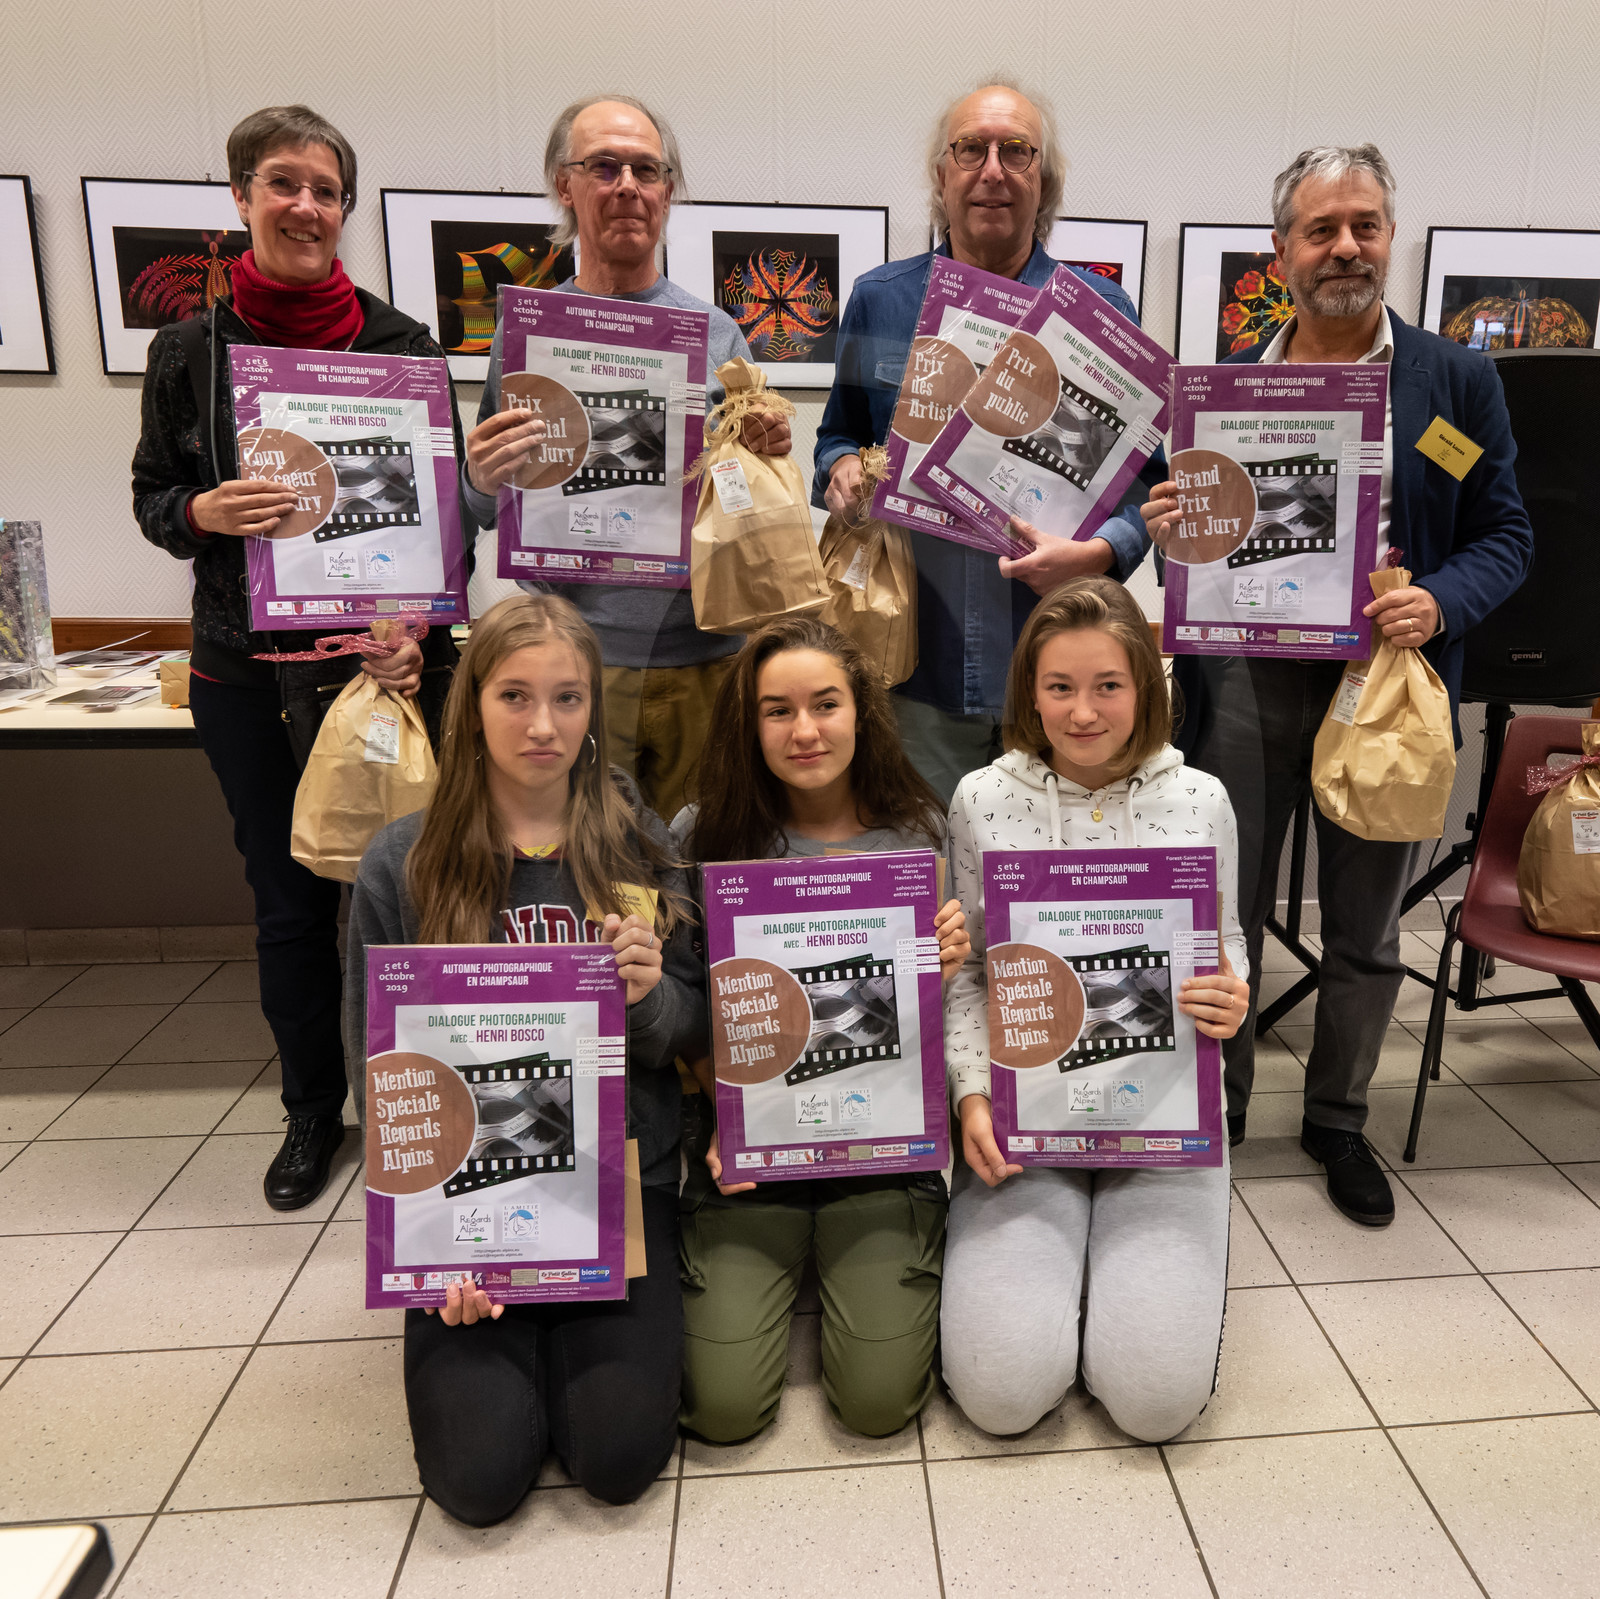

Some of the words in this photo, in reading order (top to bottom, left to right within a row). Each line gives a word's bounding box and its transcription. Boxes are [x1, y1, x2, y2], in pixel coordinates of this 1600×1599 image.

[939, 279, 964, 291] octobre
[942, 288, 958, 298] 2019
[984, 286, 1010, 302] AUTOMNE
[517, 298, 523, 306] 5
[998, 302, 1006, 310] EN
[513, 305, 542, 315] octobre
[566, 306, 596, 318] AUTOMNE
[598, 309, 652, 325] PHOTOGRAPHIQUE
[518, 315, 536, 325] 2019
[585, 319, 594, 328] EN
[595, 320, 634, 333] CHAMPSAUR
[964, 320, 997, 338] DIALOGUE
[1092, 308, 1117, 331] AUTOMNE
[1114, 326, 1156, 363] PHOTOGRAPHIQUE
[1100, 327, 1110, 337] EN
[1107, 332, 1138, 360] CHAMPSAUR
[553, 347, 591, 360] DIALOGUE
[594, 351, 662, 369] PHOTOGRAPHIQUE
[914, 352, 945, 374] Prix
[1006, 347, 1037, 378] Prix
[297, 363, 329, 373] AUTOMNE
[331, 365, 388, 377] PHOTOGRAPHIQUE
[591, 364, 616, 376] HENRI
[618, 367, 645, 379] BOSCO
[1063, 332, 1093, 360] DIALOGUE
[1091, 355, 1143, 401] PHOTOGRAPHIQUE
[318, 374, 327, 382] EN
[329, 375, 369, 385] CHAMPSAUR
[911, 375, 933, 396] des
[996, 368, 1015, 392] du
[1082, 363, 1105, 384] HENRI
[1101, 378, 1125, 400] BOSCO
[1234, 377, 1265, 386] AUTOMNE
[1267, 377, 1325, 386] PHOTOGRAPHIQUE
[1253, 388, 1262, 396] EN
[1264, 388, 1304, 396] CHAMPSAUR
[288, 402, 328, 412] DIALOGUE
[331, 403, 403, 416] PHOTOGRAPHIQUE
[507, 394, 542, 413] Prix
[909, 398, 958, 421] Artist
[983, 392, 1029, 425] public
[330, 415, 356, 426] HENRI
[358, 416, 386, 427] BOSCO
[1221, 420, 1260, 429] DIALOGUE
[1262, 420, 1334, 430] PHOTOGRAPHIQUE
[1259, 433, 1285, 443] HENRI
[1287, 433, 1315, 443] BOSCO
[244, 447, 286, 470] Coup
[539, 443, 575, 466] Jury
[1175, 464, 1220, 490] Grand
[1176, 494, 1211, 513] Prix
[1179, 519, 1198, 539] du
[1204, 515, 1241, 537] Jury
[1512, 652, 1542, 661] gemini
[997, 864, 1003, 872] 5
[1014, 862, 1020, 870] 6
[1049, 864, 1083, 874] AUTOMNE
[1085, 862, 1149, 873] PHOTOGRAPHIQUE
[721, 878, 727, 886] 5
[773, 875, 807, 886] AUTOMNE
[809, 871, 871, 884] PHOTOGRAPHIQUE
[993, 872, 1024, 880] octobre
[1071, 876, 1081, 885] EN
[1083, 875, 1127, 885] CHAMPSAUR
[716, 885, 748, 895] octobre
[795, 887, 805, 896] EN
[807, 884, 851, 896] CHAMPSAUR
[999, 883, 1019, 891] 2019
[723, 896, 743, 905] 2019
[1038, 911, 1081, 921] DIALOGUE
[1084, 908, 1163, 921] PHOTOGRAPHIQUE
[763, 922, 806, 935] DIALOGUE
[808, 917, 886, 932] PHOTOGRAPHIQUE
[1081, 924, 1110, 935] HENRI
[1113, 923, 1144, 934] BOSCO
[806, 934, 835, 947] HENRI
[837, 932, 867, 945] BOSCO
[384, 963, 390, 971] 5
[403, 961, 409, 969] 6
[442, 963, 480, 974] AUTOMNE
[483, 961, 552, 973] PHOTOGRAPHIQUE
[992, 957, 1048, 979] Mention
[378, 971, 414, 981] octobre
[467, 976, 477, 986] EN
[479, 975, 528, 986] CHAMPSAUR
[716, 971, 774, 996] Mention
[386, 983, 407, 993] 2019
[996, 978, 1053, 1005] Spéciale
[721, 992, 779, 1022] Spéciale
[1000, 1002, 1054, 1026] Regards
[428, 1015, 476, 1027] DIALOGUE
[479, 1012, 565, 1026] PHOTOGRAPHIQUE
[476, 1029, 507, 1042] HENRI
[510, 1028, 544, 1041] BOSCO
[724, 1016, 780, 1042] Regards
[1004, 1027, 1049, 1051] Alpins
[729, 1043, 775, 1066] Alpins
[372, 1068, 436, 1094] Mention
[376, 1091, 441, 1123] Spéciale
[378, 1117, 441, 1146] Regards
[382, 1148, 434, 1174] Alpins
